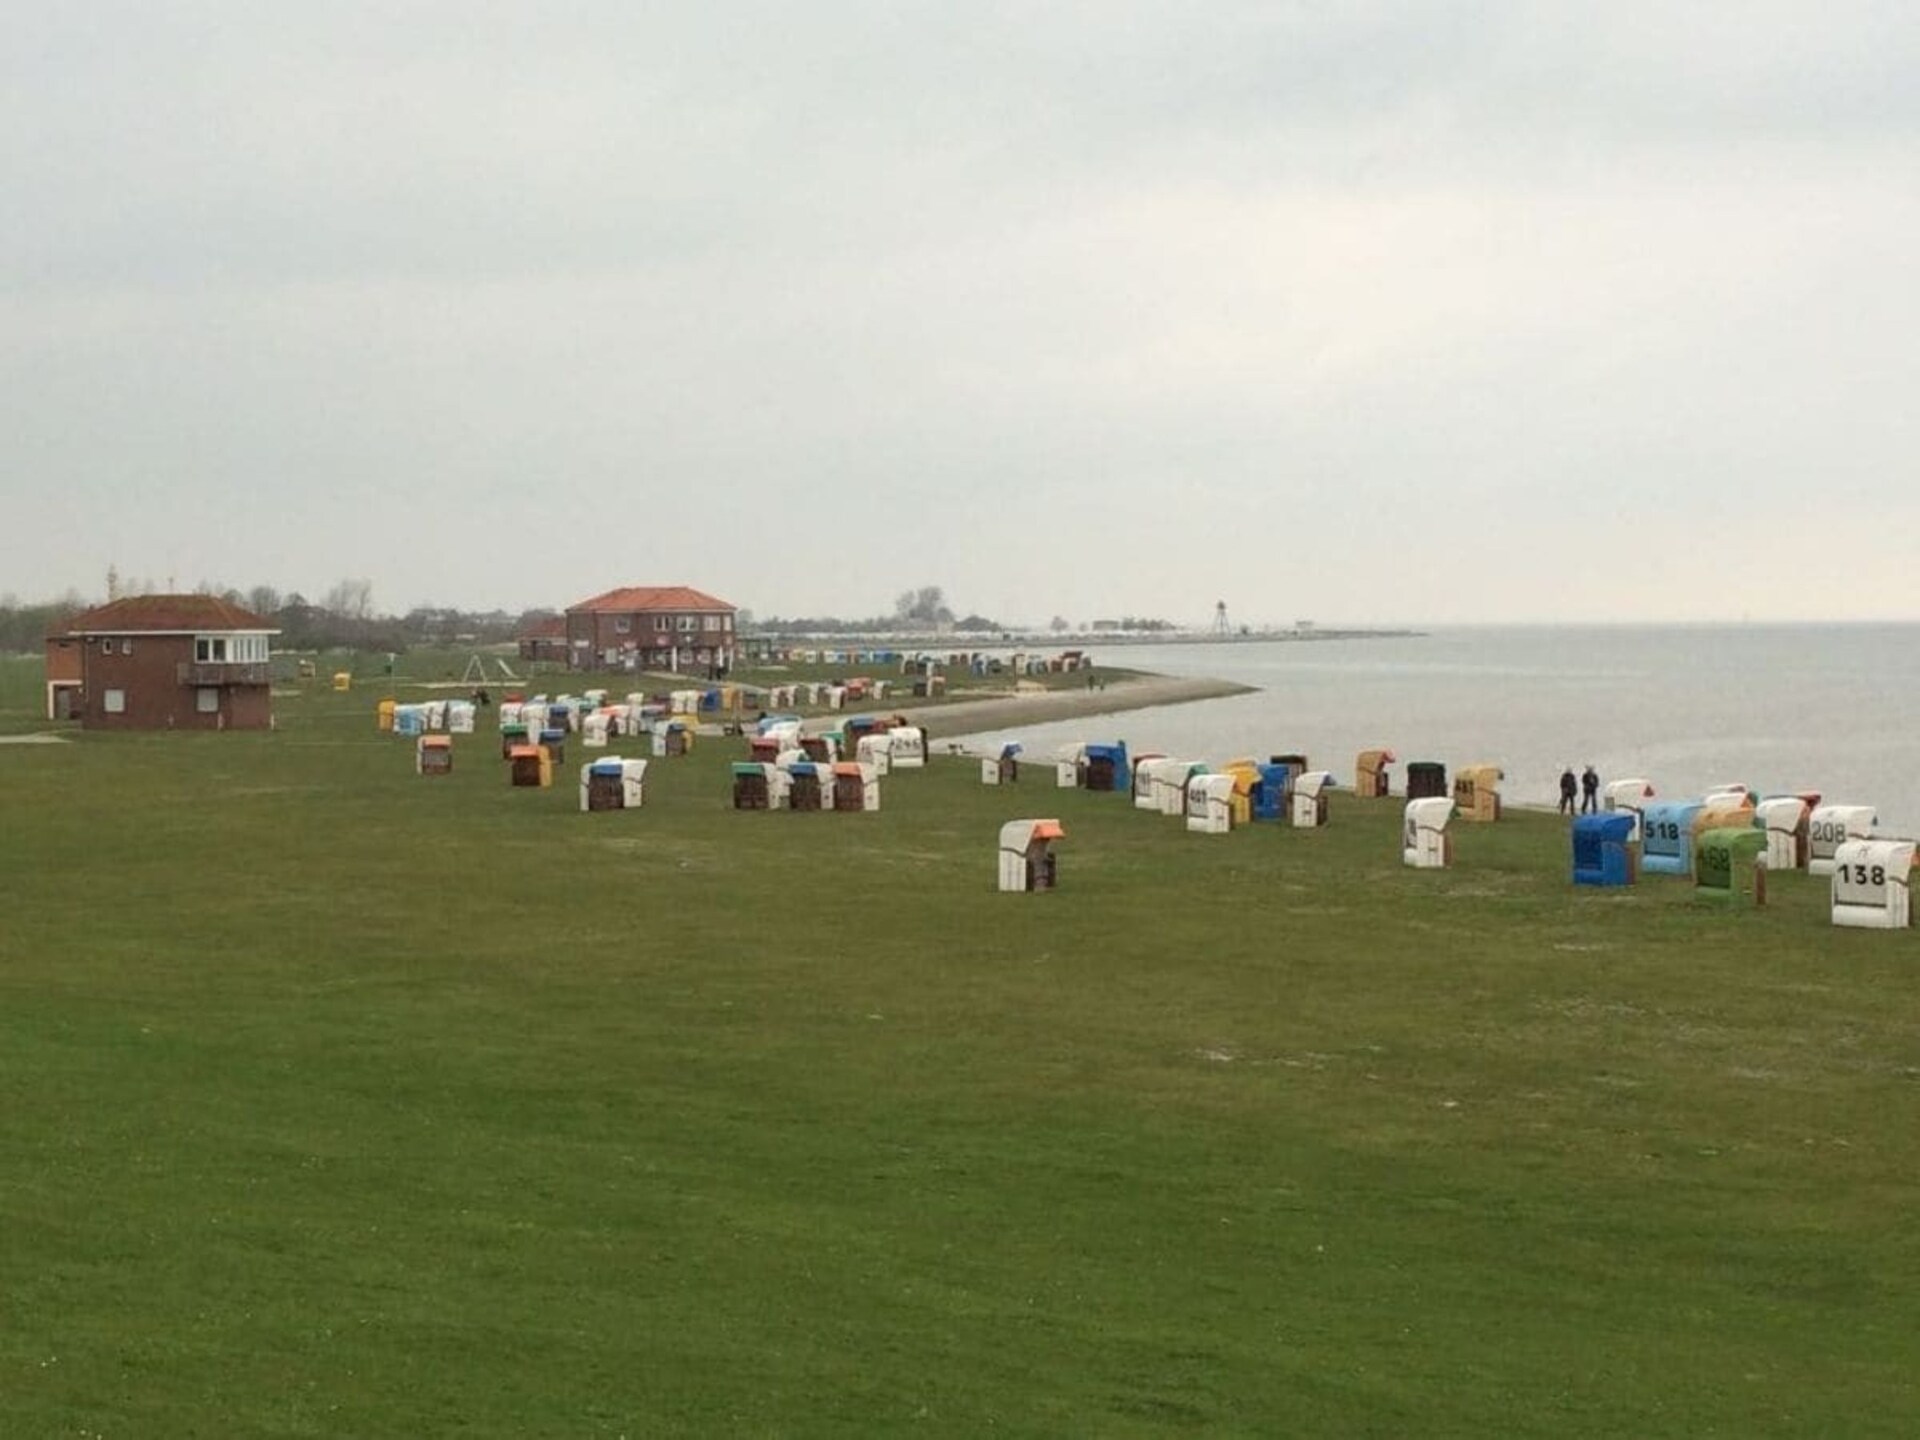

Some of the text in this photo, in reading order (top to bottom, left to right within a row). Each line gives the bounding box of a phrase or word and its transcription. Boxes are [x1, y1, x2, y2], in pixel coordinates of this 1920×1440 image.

[1645, 821, 1679, 840] 518
[1811, 820, 1846, 843] 208
[1837, 864, 1885, 886] 138
